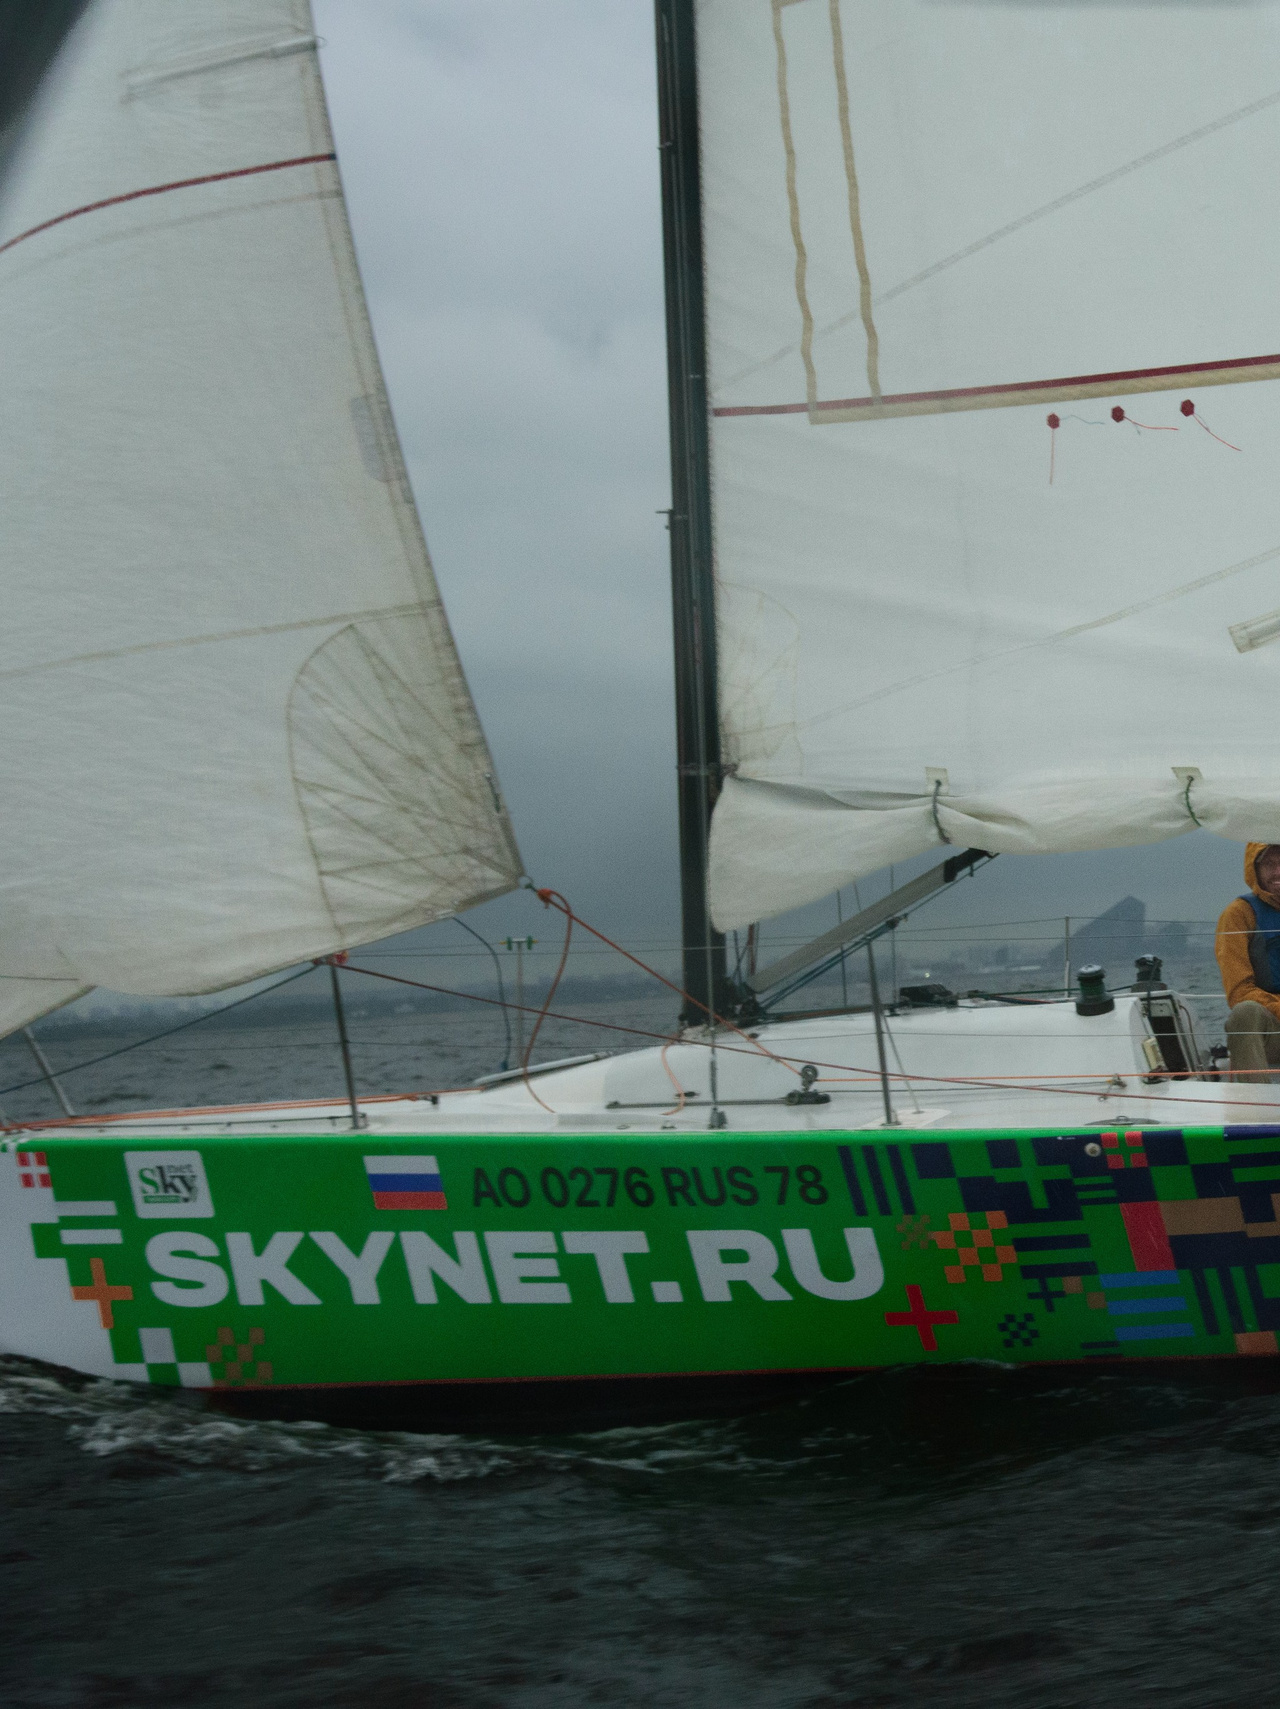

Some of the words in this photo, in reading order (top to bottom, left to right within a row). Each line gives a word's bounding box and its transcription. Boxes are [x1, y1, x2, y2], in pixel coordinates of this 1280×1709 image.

[139, 1166, 197, 1203] Sky
[540, 1166, 655, 1207] 0276
[661, 1166, 759, 1206] RUS
[763, 1164, 829, 1206] 78
[145, 1227, 885, 1307] SKYNET.RU
